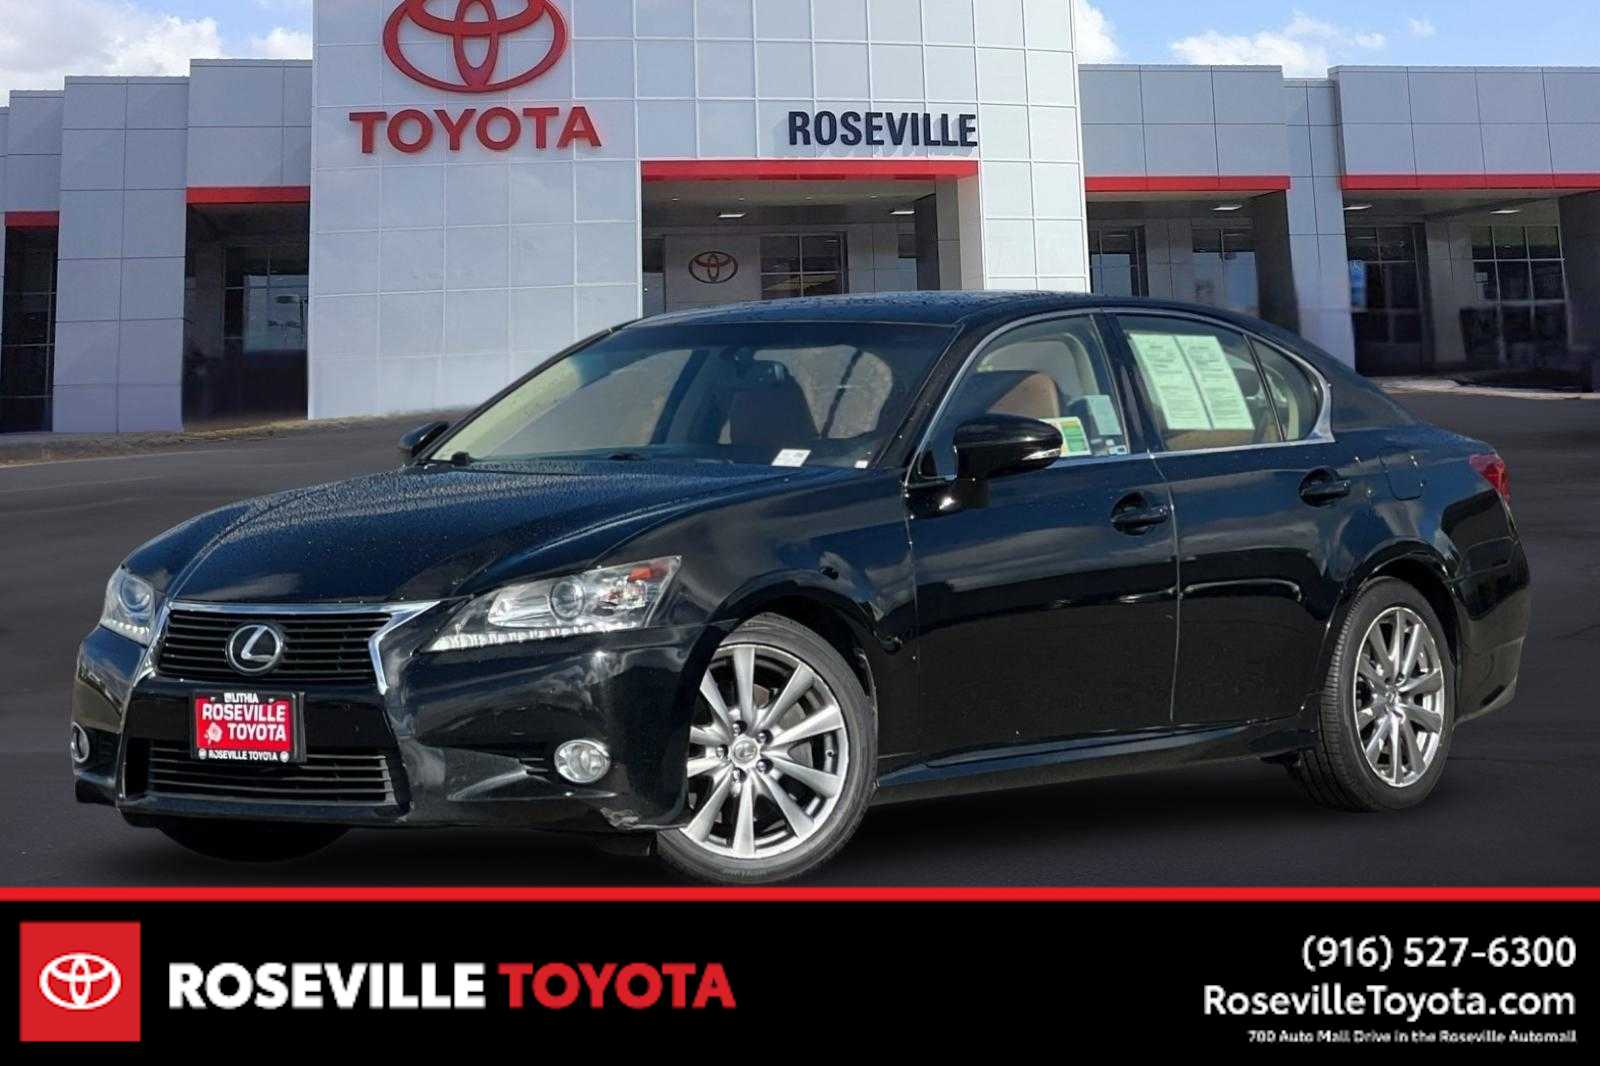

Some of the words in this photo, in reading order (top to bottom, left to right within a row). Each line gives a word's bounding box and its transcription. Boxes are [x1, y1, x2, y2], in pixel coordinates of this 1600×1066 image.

[349, 106, 602, 154] TOYOTA
[788, 110, 978, 147] ROSEVILLE
[202, 703, 286, 722] ROSEVILLE
[227, 723, 287, 742] TOYOTA
[208, 750, 247, 761] ROSEVILLE
[249, 751, 279, 761] TOYOTA
